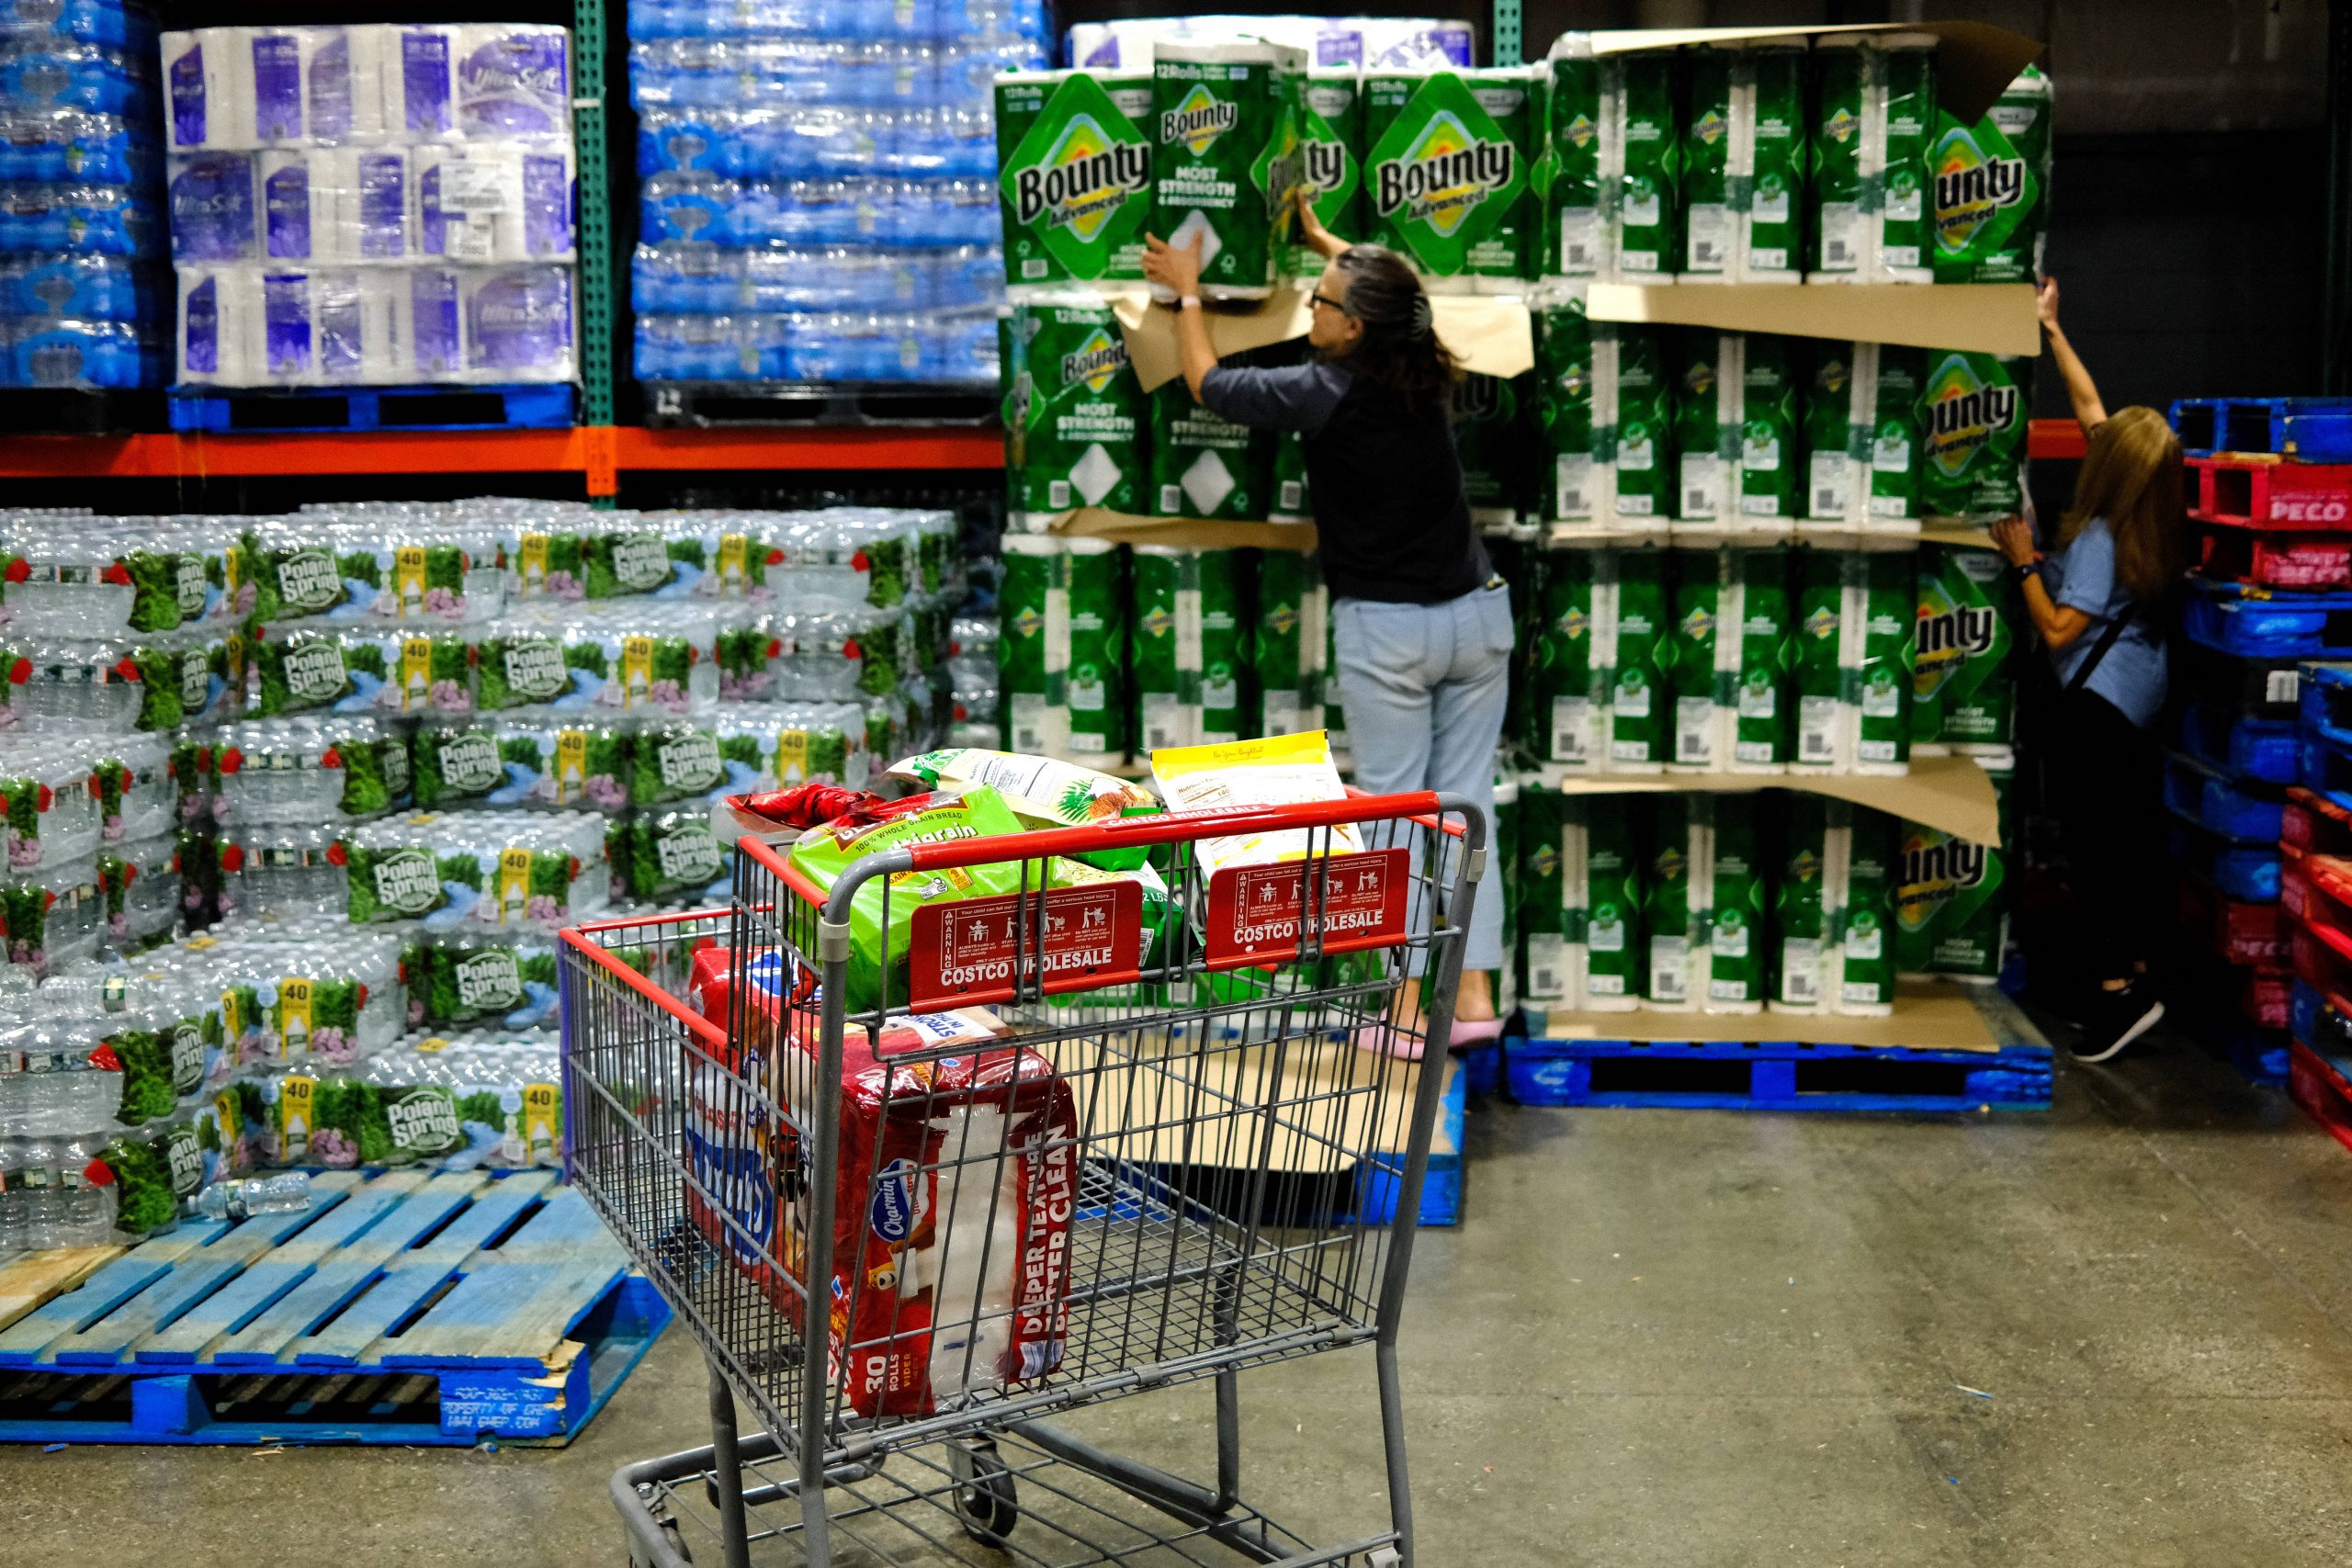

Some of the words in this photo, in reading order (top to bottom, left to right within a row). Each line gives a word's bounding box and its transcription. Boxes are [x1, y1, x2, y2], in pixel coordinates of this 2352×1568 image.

[1164, 101, 1237, 142] Bounty
[1016, 141, 1151, 223] Bounty
[1378, 140, 1513, 216] Bounty
[1937, 157, 2023, 211] unty
[1939, 203, 1997, 230] vanced
[2270, 502, 2346, 523] PECO
[278, 554, 338, 581] Poland
[401, 551, 422, 565] 40
[282, 572, 342, 603] Spring
[284, 645, 344, 674] Poland
[406, 644, 427, 657] 40
[506, 642, 564, 672] Poland
[628, 643, 649, 656] 40
[288, 663, 347, 694] Spring
[509, 661, 567, 691] Spring
[439, 736, 499, 764] Poland
[561, 737, 581, 750] 40
[659, 737, 719, 764] Poland
[442, 754, 502, 785] Spring
[661, 754, 722, 785] Spring
[1108, 814, 1169, 827] COSTCO
[1172, 805, 1261, 819] WHOLESALE
[658, 831, 718, 858] Poland
[855, 836, 877, 852] 100%
[877, 824, 907, 840] WHOLE
[908, 814, 934, 826] GRAIN
[936, 811, 963, 819] BREAD
[375, 854, 437, 883] Poland
[505, 854, 526, 868] 40
[660, 849, 721, 878] Spring
[1903, 838, 1984, 886] unty
[377, 874, 441, 905] Spring
[1238, 880, 1248, 927] WARNING
[944, 919, 954, 968] WARNING
[1234, 922, 1294, 944] COSTCO
[457, 955, 519, 987] Poland
[941, 961, 1009, 987] COSTCO
[286, 985, 307, 999] 40
[459, 975, 521, 1007] Spring
[287, 1083, 309, 1099] 40
[529, 1090, 550, 1105] 40
[388, 1093, 456, 1125] Poland
[391, 1116, 458, 1148] Spring
[1046, 1123, 1071, 1223] CLEAN
[879, 1179, 904, 1235] Charmin
[865, 1355, 888, 1394] 30
[889, 1354, 899, 1392] ROLLS
